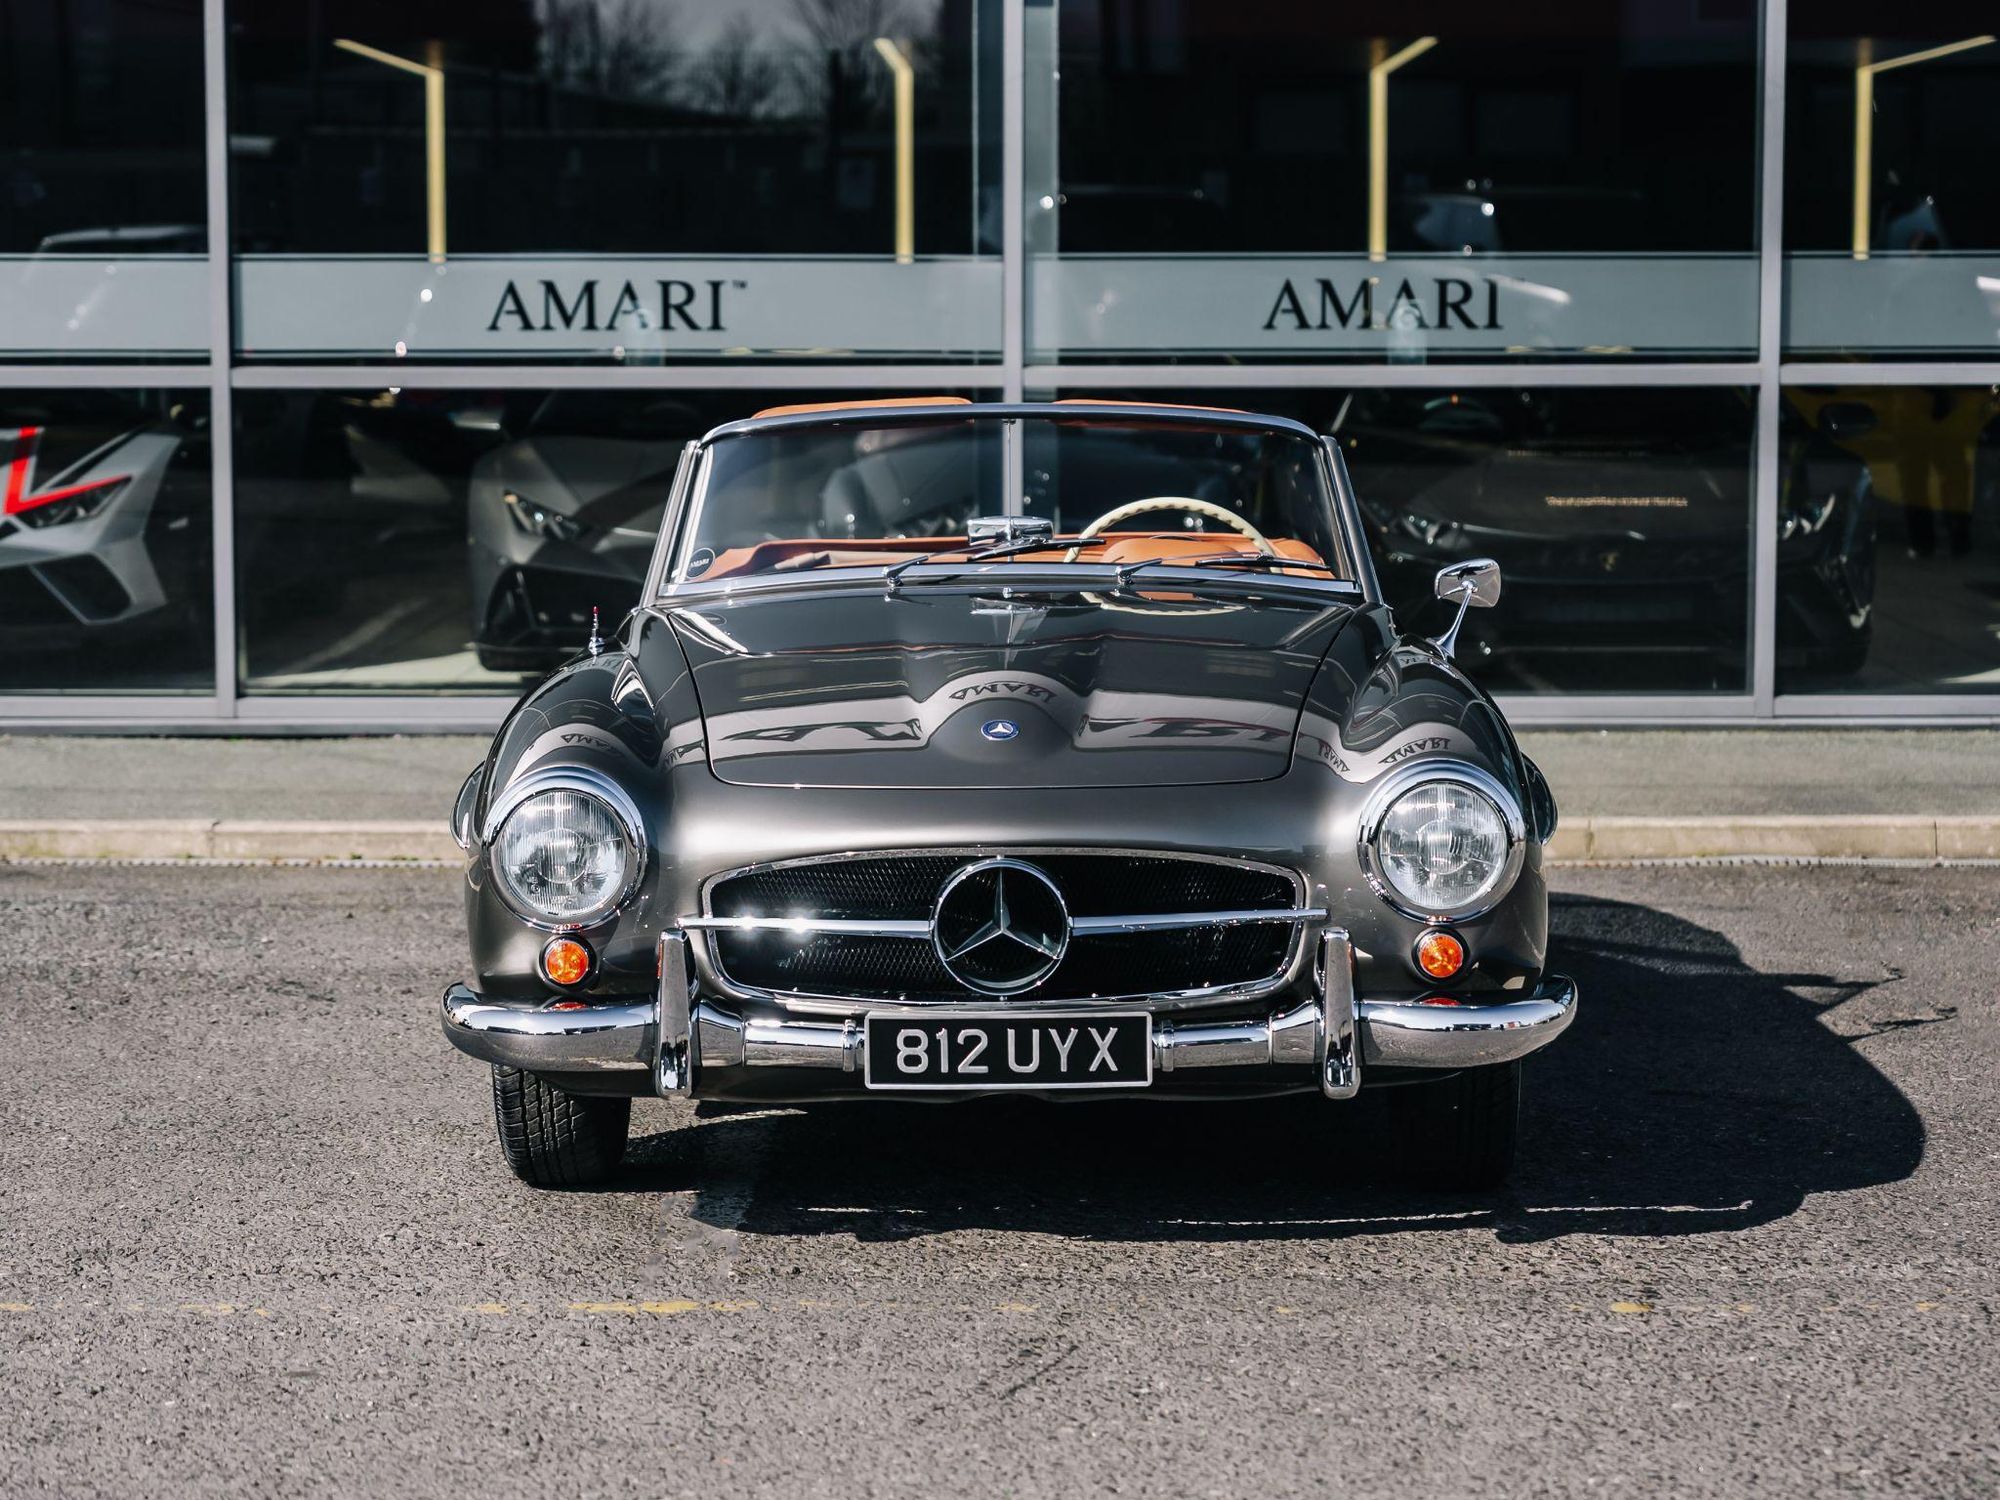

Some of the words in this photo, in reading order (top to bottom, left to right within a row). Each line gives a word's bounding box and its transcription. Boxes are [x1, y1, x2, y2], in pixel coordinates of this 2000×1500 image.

[1262, 277, 1504, 330] AMARI
[896, 1028, 989, 1074] 812
[1007, 1027, 1118, 1073] UYX
